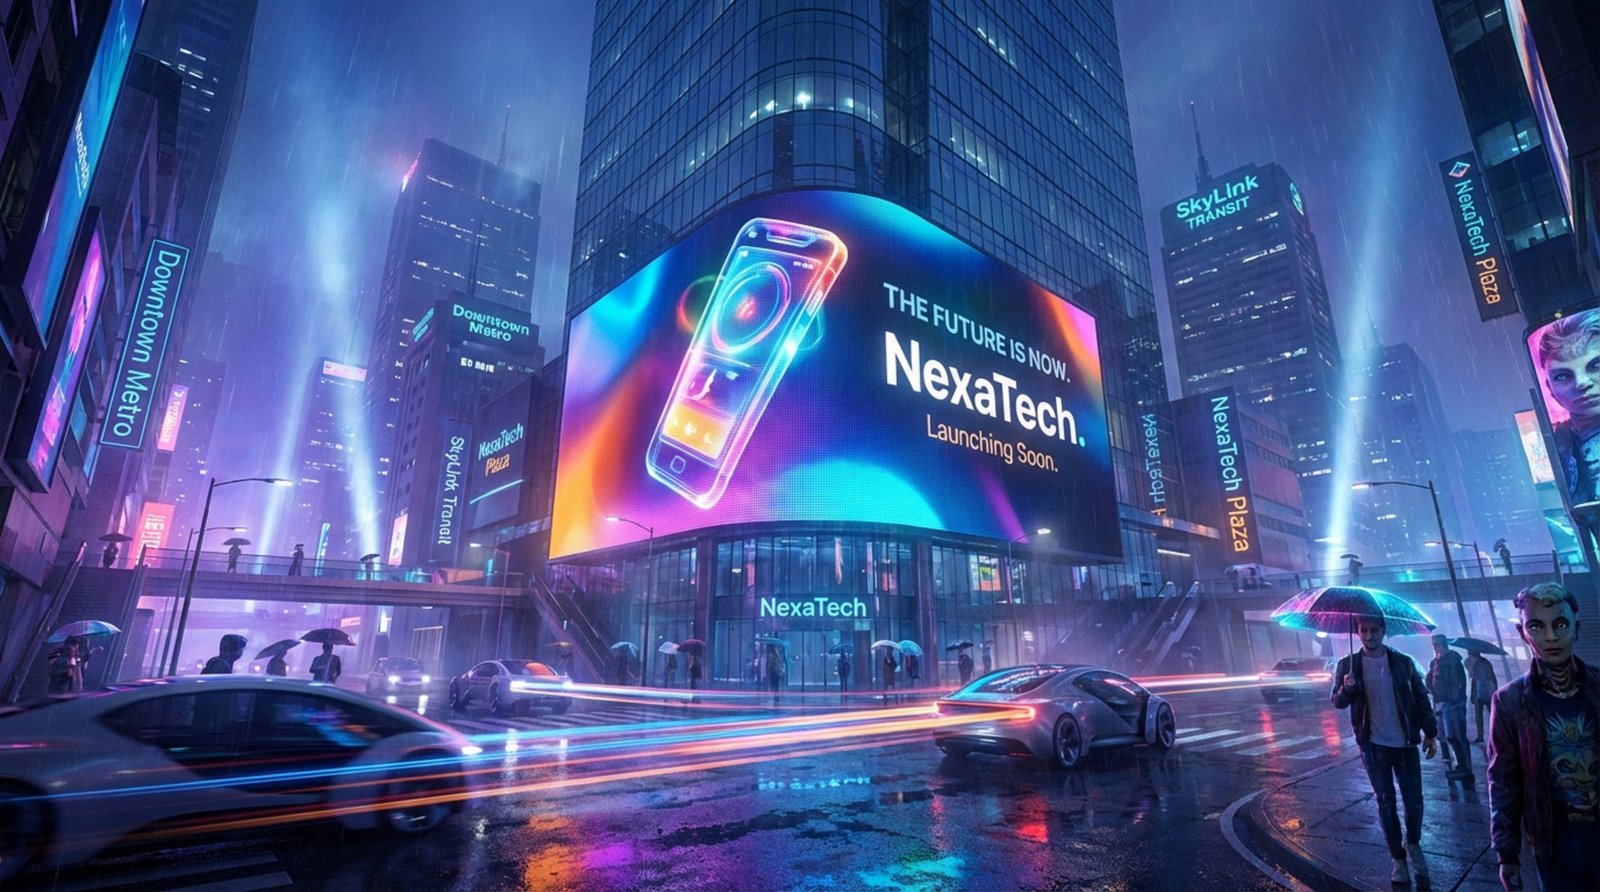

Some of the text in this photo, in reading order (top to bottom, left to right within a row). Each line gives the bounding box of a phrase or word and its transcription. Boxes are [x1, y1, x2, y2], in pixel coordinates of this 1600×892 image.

[1185, 195, 1250, 229] TRANSIT
[1454, 179, 1501, 304] NexaTech Plaza
[131, 249, 181, 363] Downtown
[883, 282, 1071, 384] THE FUTURE IS NOW.
[113, 369, 152, 437] Metro
[926, 414, 1059, 473] Launching Soon.
[1211, 396, 1249, 553] NexaTech Plaza
[760, 597, 867, 618] NexaTech
